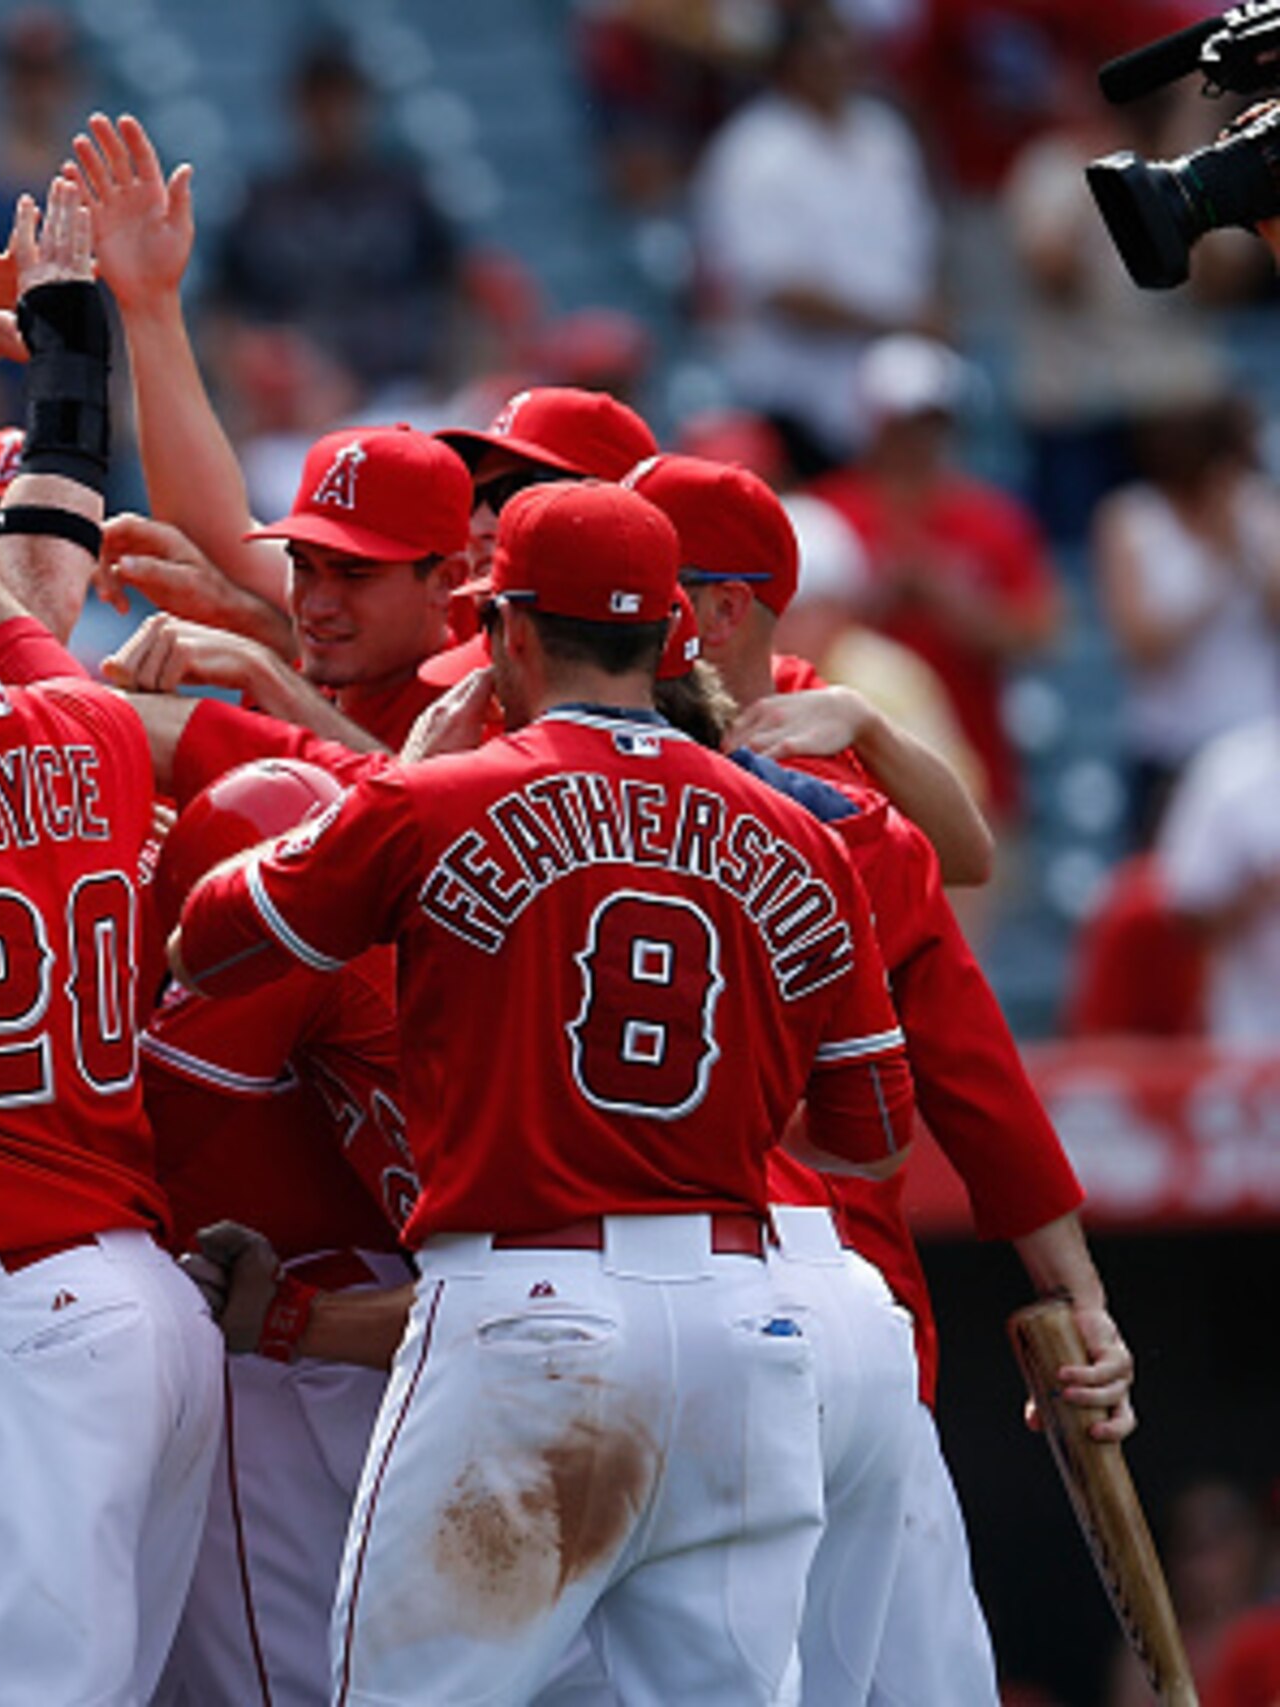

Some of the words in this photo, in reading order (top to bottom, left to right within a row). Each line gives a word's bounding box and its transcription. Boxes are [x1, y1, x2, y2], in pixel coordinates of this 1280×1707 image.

[312, 439, 366, 510] A
[418, 771, 855, 1001] FEATHERSTON
[565, 888, 725, 1121] 8
